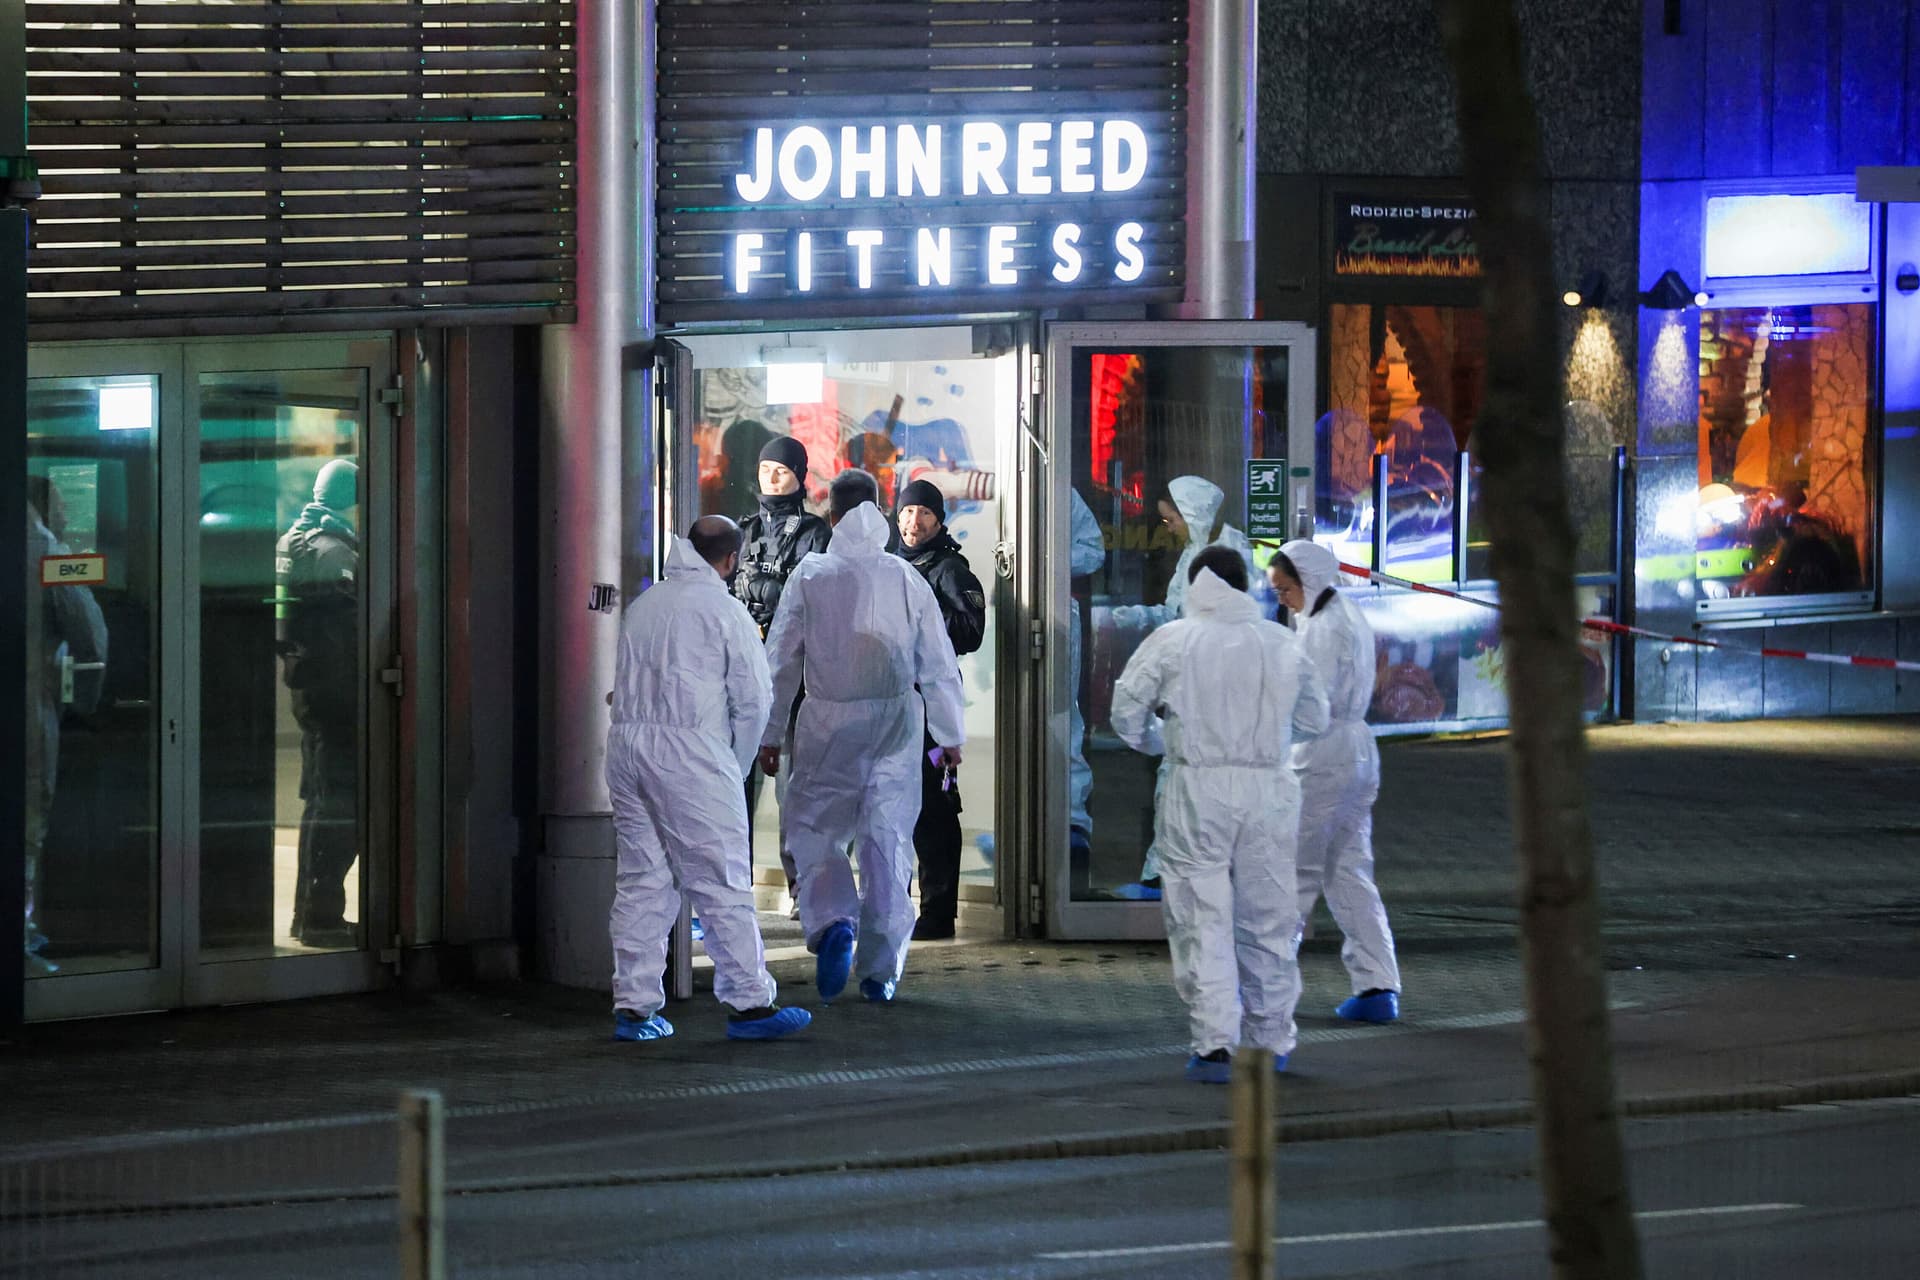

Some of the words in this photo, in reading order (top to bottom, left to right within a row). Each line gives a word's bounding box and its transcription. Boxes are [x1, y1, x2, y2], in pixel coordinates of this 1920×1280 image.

[735, 124, 941, 202] JOHN
[962, 120, 1148, 195] REED
[735, 222, 1145, 293] FITNESS
[59, 563, 88, 576] BMZ
